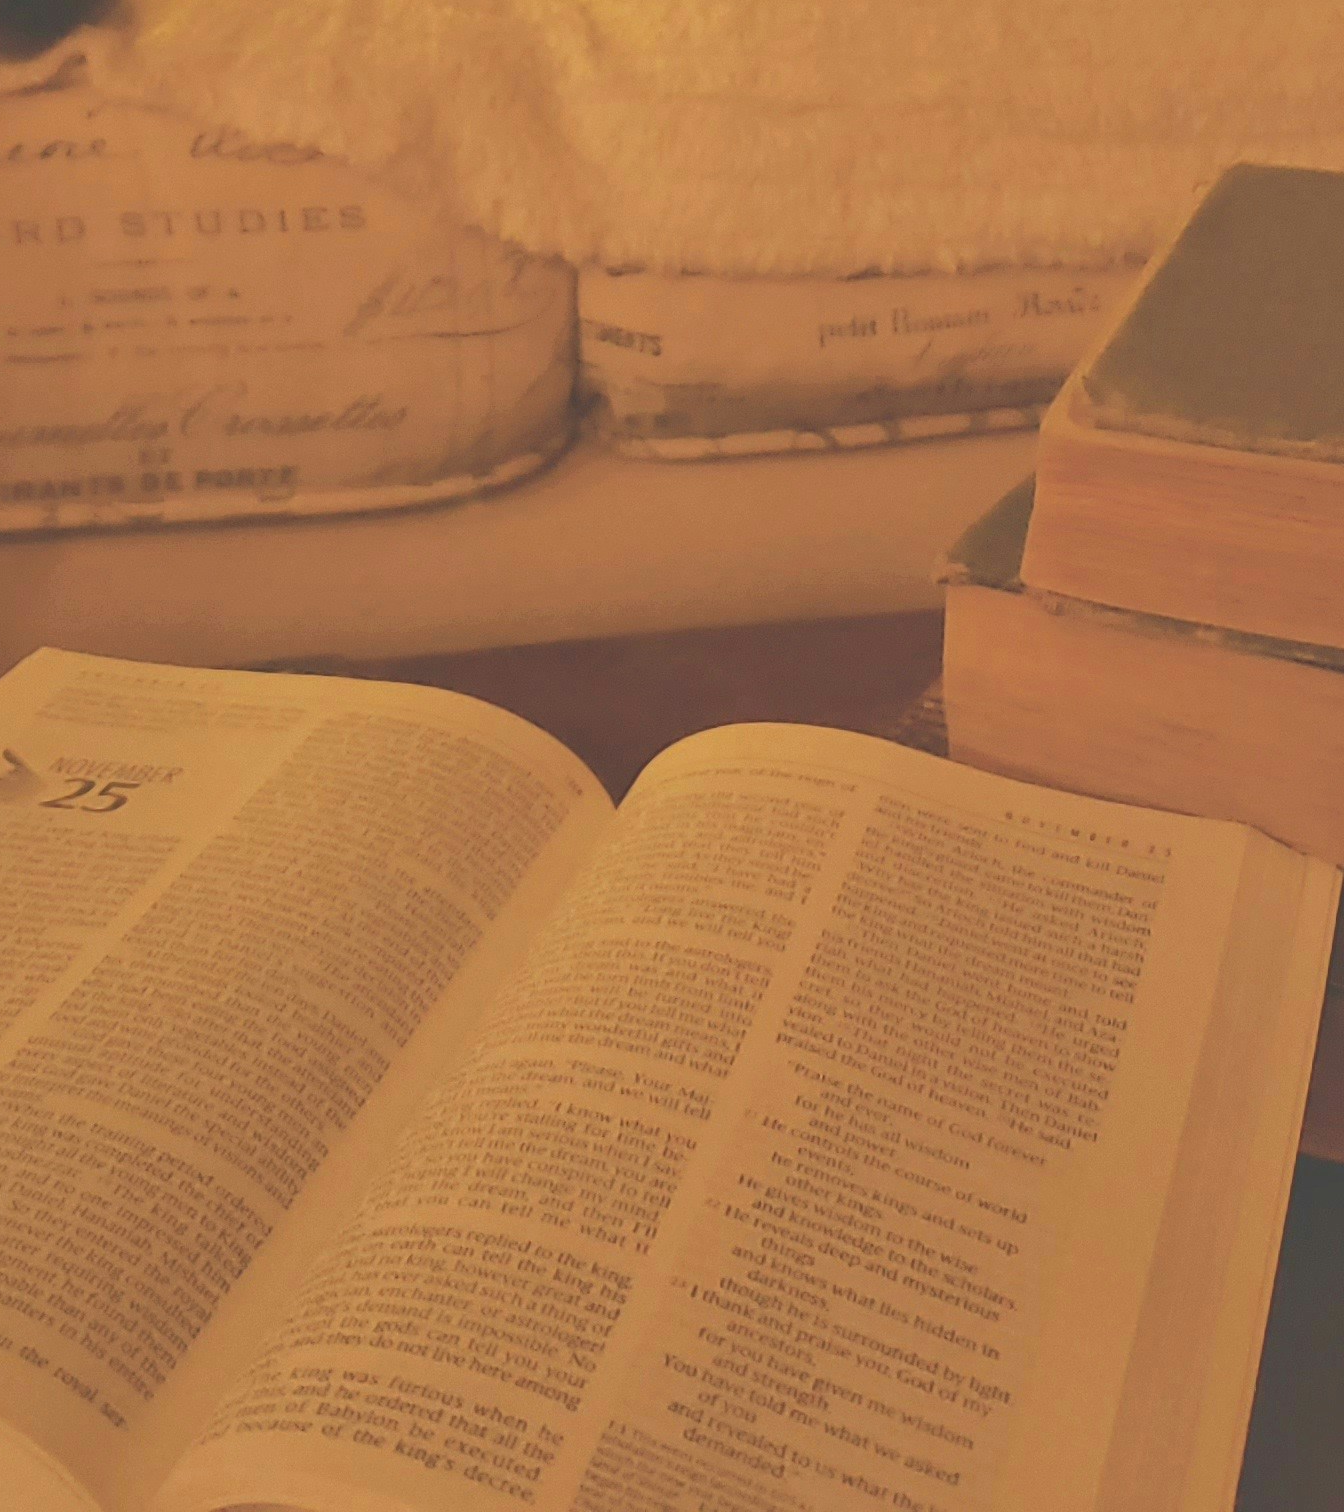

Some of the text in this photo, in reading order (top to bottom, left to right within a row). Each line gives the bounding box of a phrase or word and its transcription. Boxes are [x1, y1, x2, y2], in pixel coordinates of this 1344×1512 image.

[119, 204, 368, 237] STUDIES
[38, 777, 143, 814] 25
[49, 756, 186, 785] NOVEMBER
[794, 1091, 972, 1169] for he has all wisdom
[808, 1116, 843, 1135] and
[820, 1089, 854, 1108] and
[846, 1079, 873, 1100] the
[877, 1095, 922, 1118] name
[927, 1113, 946, 1127] of
[948, 1118, 986, 1142] God
[987, 1132, 1049, 1166] forever
[762, 1111, 1031, 1223] He controls the course of world
[771, 1148, 1021, 1257] he removes kings and sets up
[785, 1174, 831, 1198] other
[724, 1200, 1002, 1320] He reveals deep and mysterious
[738, 1170, 979, 1273] He gives wisdom to the wise
[752, 1196, 788, 1217] and
[789, 1207, 883, 1255] knowledge
[887, 1246, 907, 1265] to
[909, 1255, 939, 1277] the
[759, 1233, 816, 1266] things
[718, 1274, 785, 1310] though
[787, 1301, 808, 1320] he
[813, 1312, 829, 1329] is
[832, 1323, 942, 1373] surrounded
[942, 1363, 966, 1388] by
[731, 1245, 1002, 1359] and knows what lies hidden in
[697, 1324, 975, 1448] for you have given me wisdom
[701, 1287, 755, 1319] thank
[757, 1314, 794, 1334] and
[795, 1329, 852, 1358] praise
[895, 1365, 937, 1392] God
[938, 1386, 960, 1401] of
[962, 1396, 993, 1420] my
[712, 1354, 750, 1376] and
[284, 1397, 309, 1411] of
[316, 1399, 400, 1429] Babylon
[409, 1419, 434, 1441] be
[291, 1362, 565, 1444] king was furious when he
[293, 1379, 333, 1394] and
[335, 1381, 361, 1398] he
[365, 1391, 445, 1423] ordered
[448, 1412, 489, 1439] that
[493, 1433, 519, 1450] all
[522, 1440, 555, 1463] the
[662, 1352, 962, 1485] You have told me what we asked
[697, 1391, 759, 1421] of you
[320, 1421, 345, 1436] of
[352, 1425, 386, 1447] the
[394, 1436, 456, 1471] king's
[667, 1400, 924, 1511] and revealed to us what the
